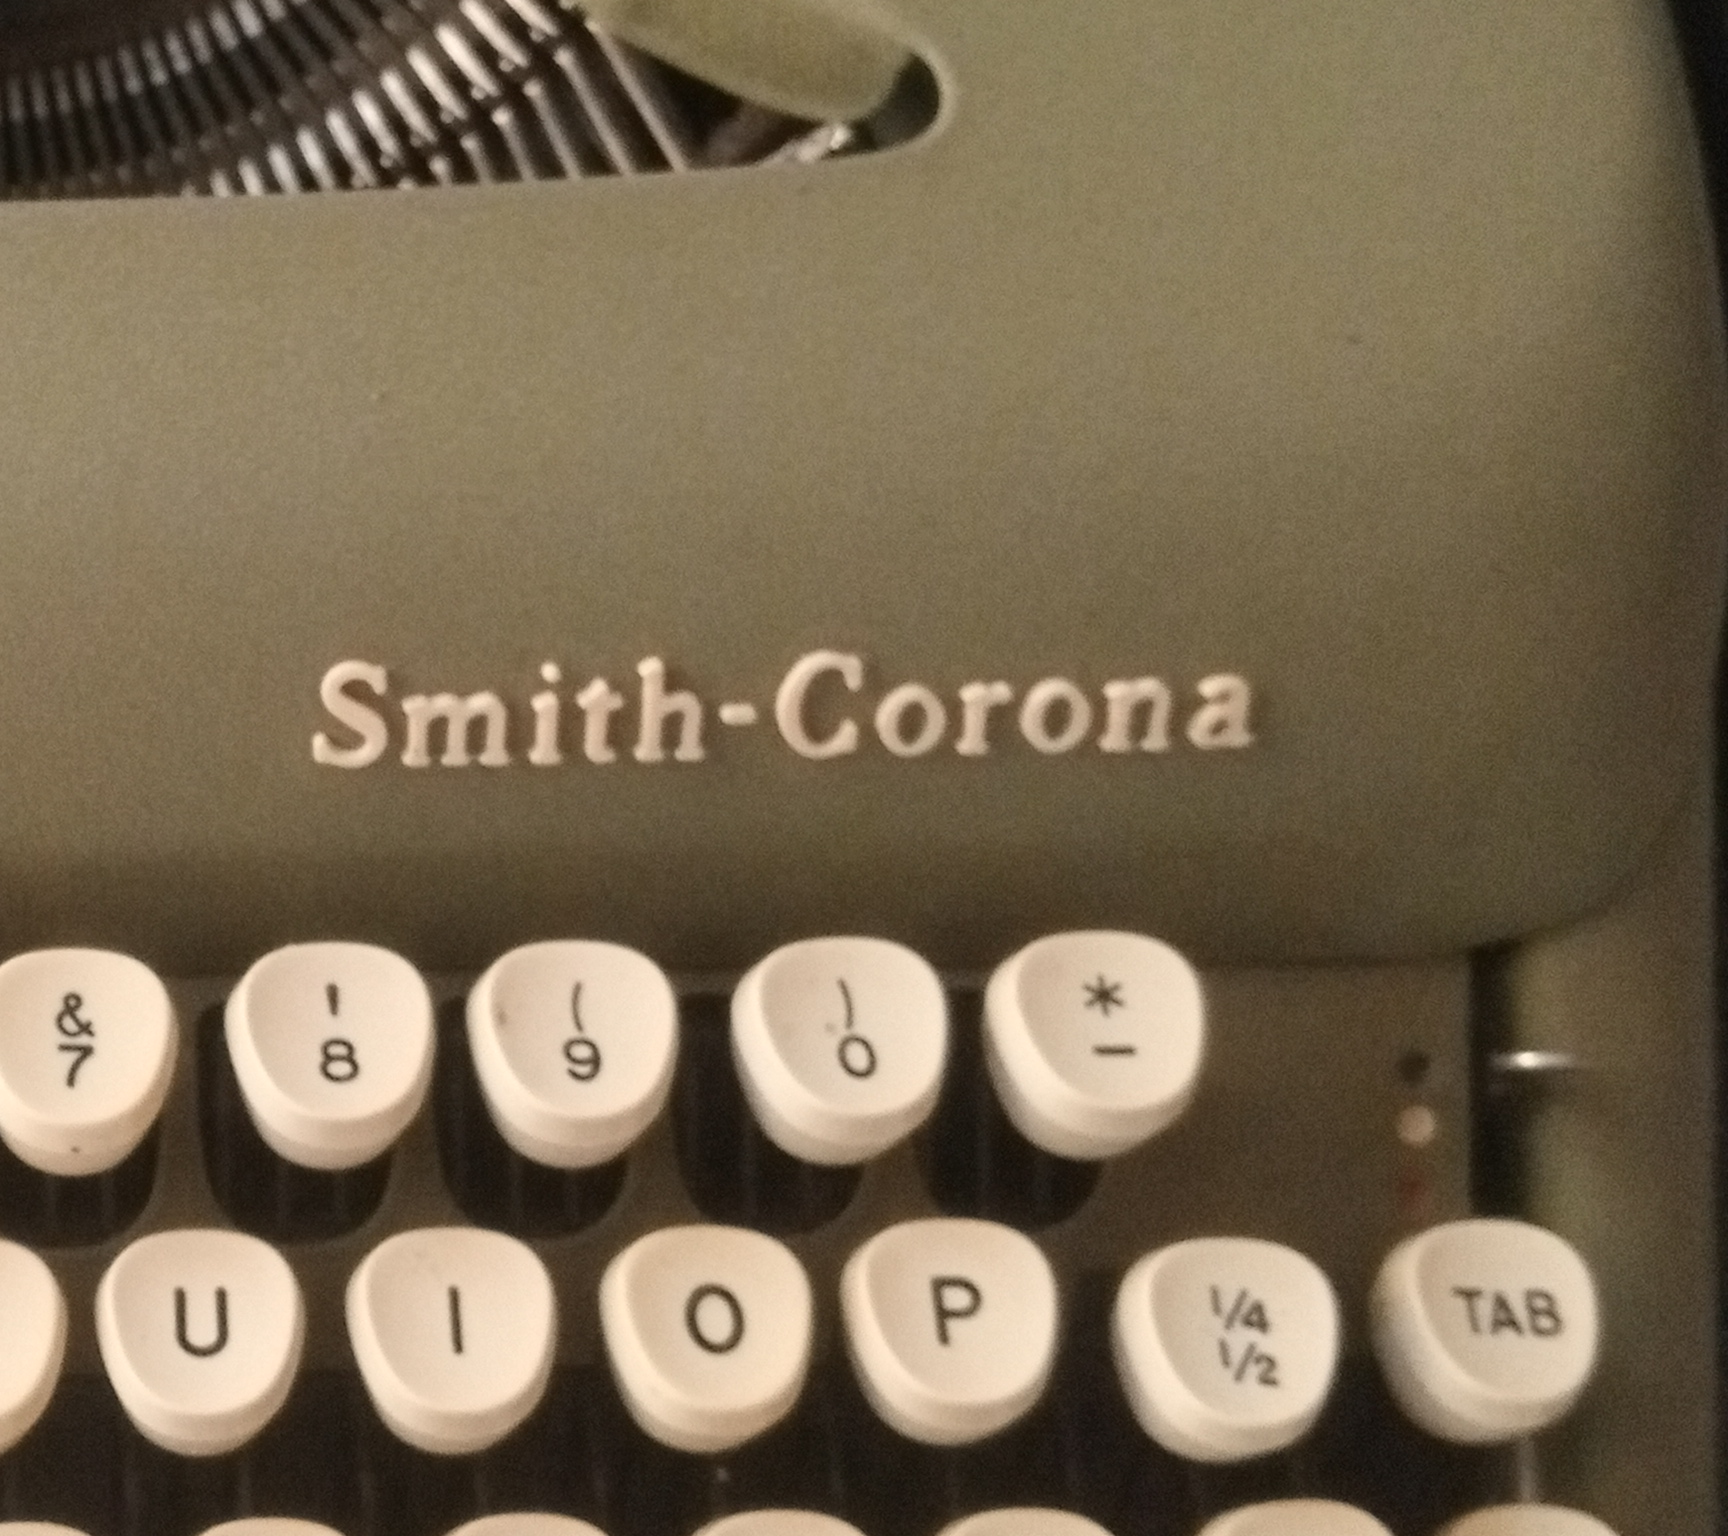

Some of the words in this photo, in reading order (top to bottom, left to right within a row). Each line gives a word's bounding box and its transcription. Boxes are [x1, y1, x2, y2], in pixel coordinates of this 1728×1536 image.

[312, 650, 1256, 769] Smith-Corona
[54, 991, 96, 1040] &
[56, 1042, 95, 1090] 7
[318, 1036, 362, 1085] 8
[561, 1035, 603, 1084] 9
[172, 1285, 231, 1360] U
[447, 1284, 465, 1356] I
[683, 1282, 747, 1357] O
[929, 1274, 984, 1348] P
[1450, 1286, 1564, 1338] TAB
